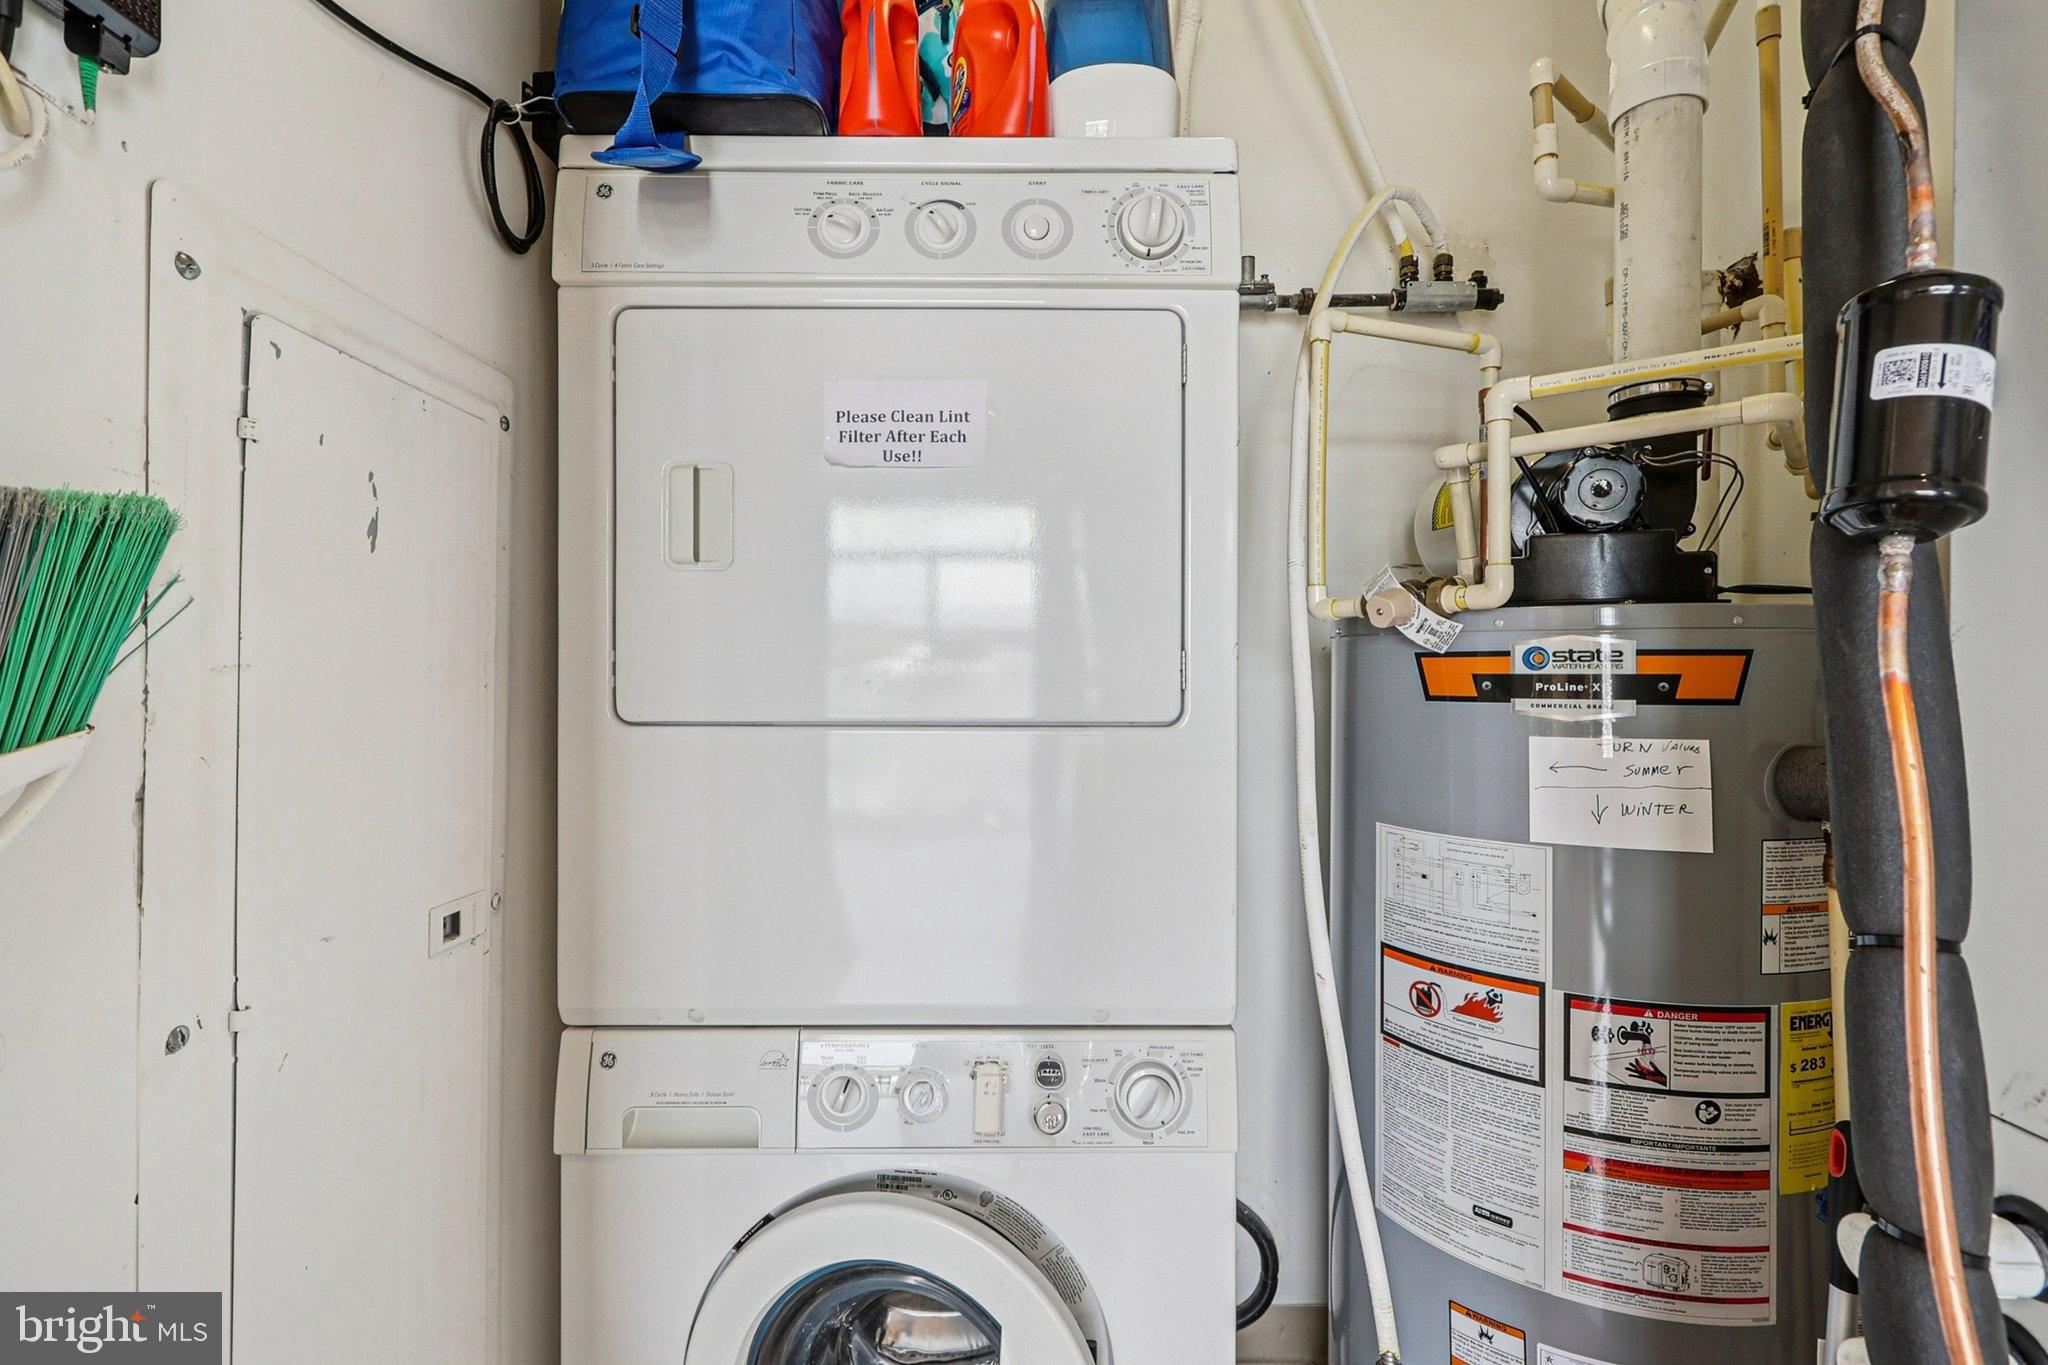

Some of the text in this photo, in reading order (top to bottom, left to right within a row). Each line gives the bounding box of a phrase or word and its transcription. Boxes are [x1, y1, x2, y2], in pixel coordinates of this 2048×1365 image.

[836, 410, 970, 423] Please Clean Lint
[839, 430, 966, 443] Filter After Each
[883, 450, 922, 462] Use!!
[1552, 648, 1624, 662] state
[1530, 702, 1583, 710] COMMERCIAL
[1596, 742, 1653, 753] URN
[1436, 966, 1473, 982] WARNING
[1657, 1011, 1698, 1021] DANGER
[1790, 1012, 1832, 1031] ENERG
[1790, 1056, 1826, 1073] $ 283
[1471, 1313, 1506, 1332] WARNING
